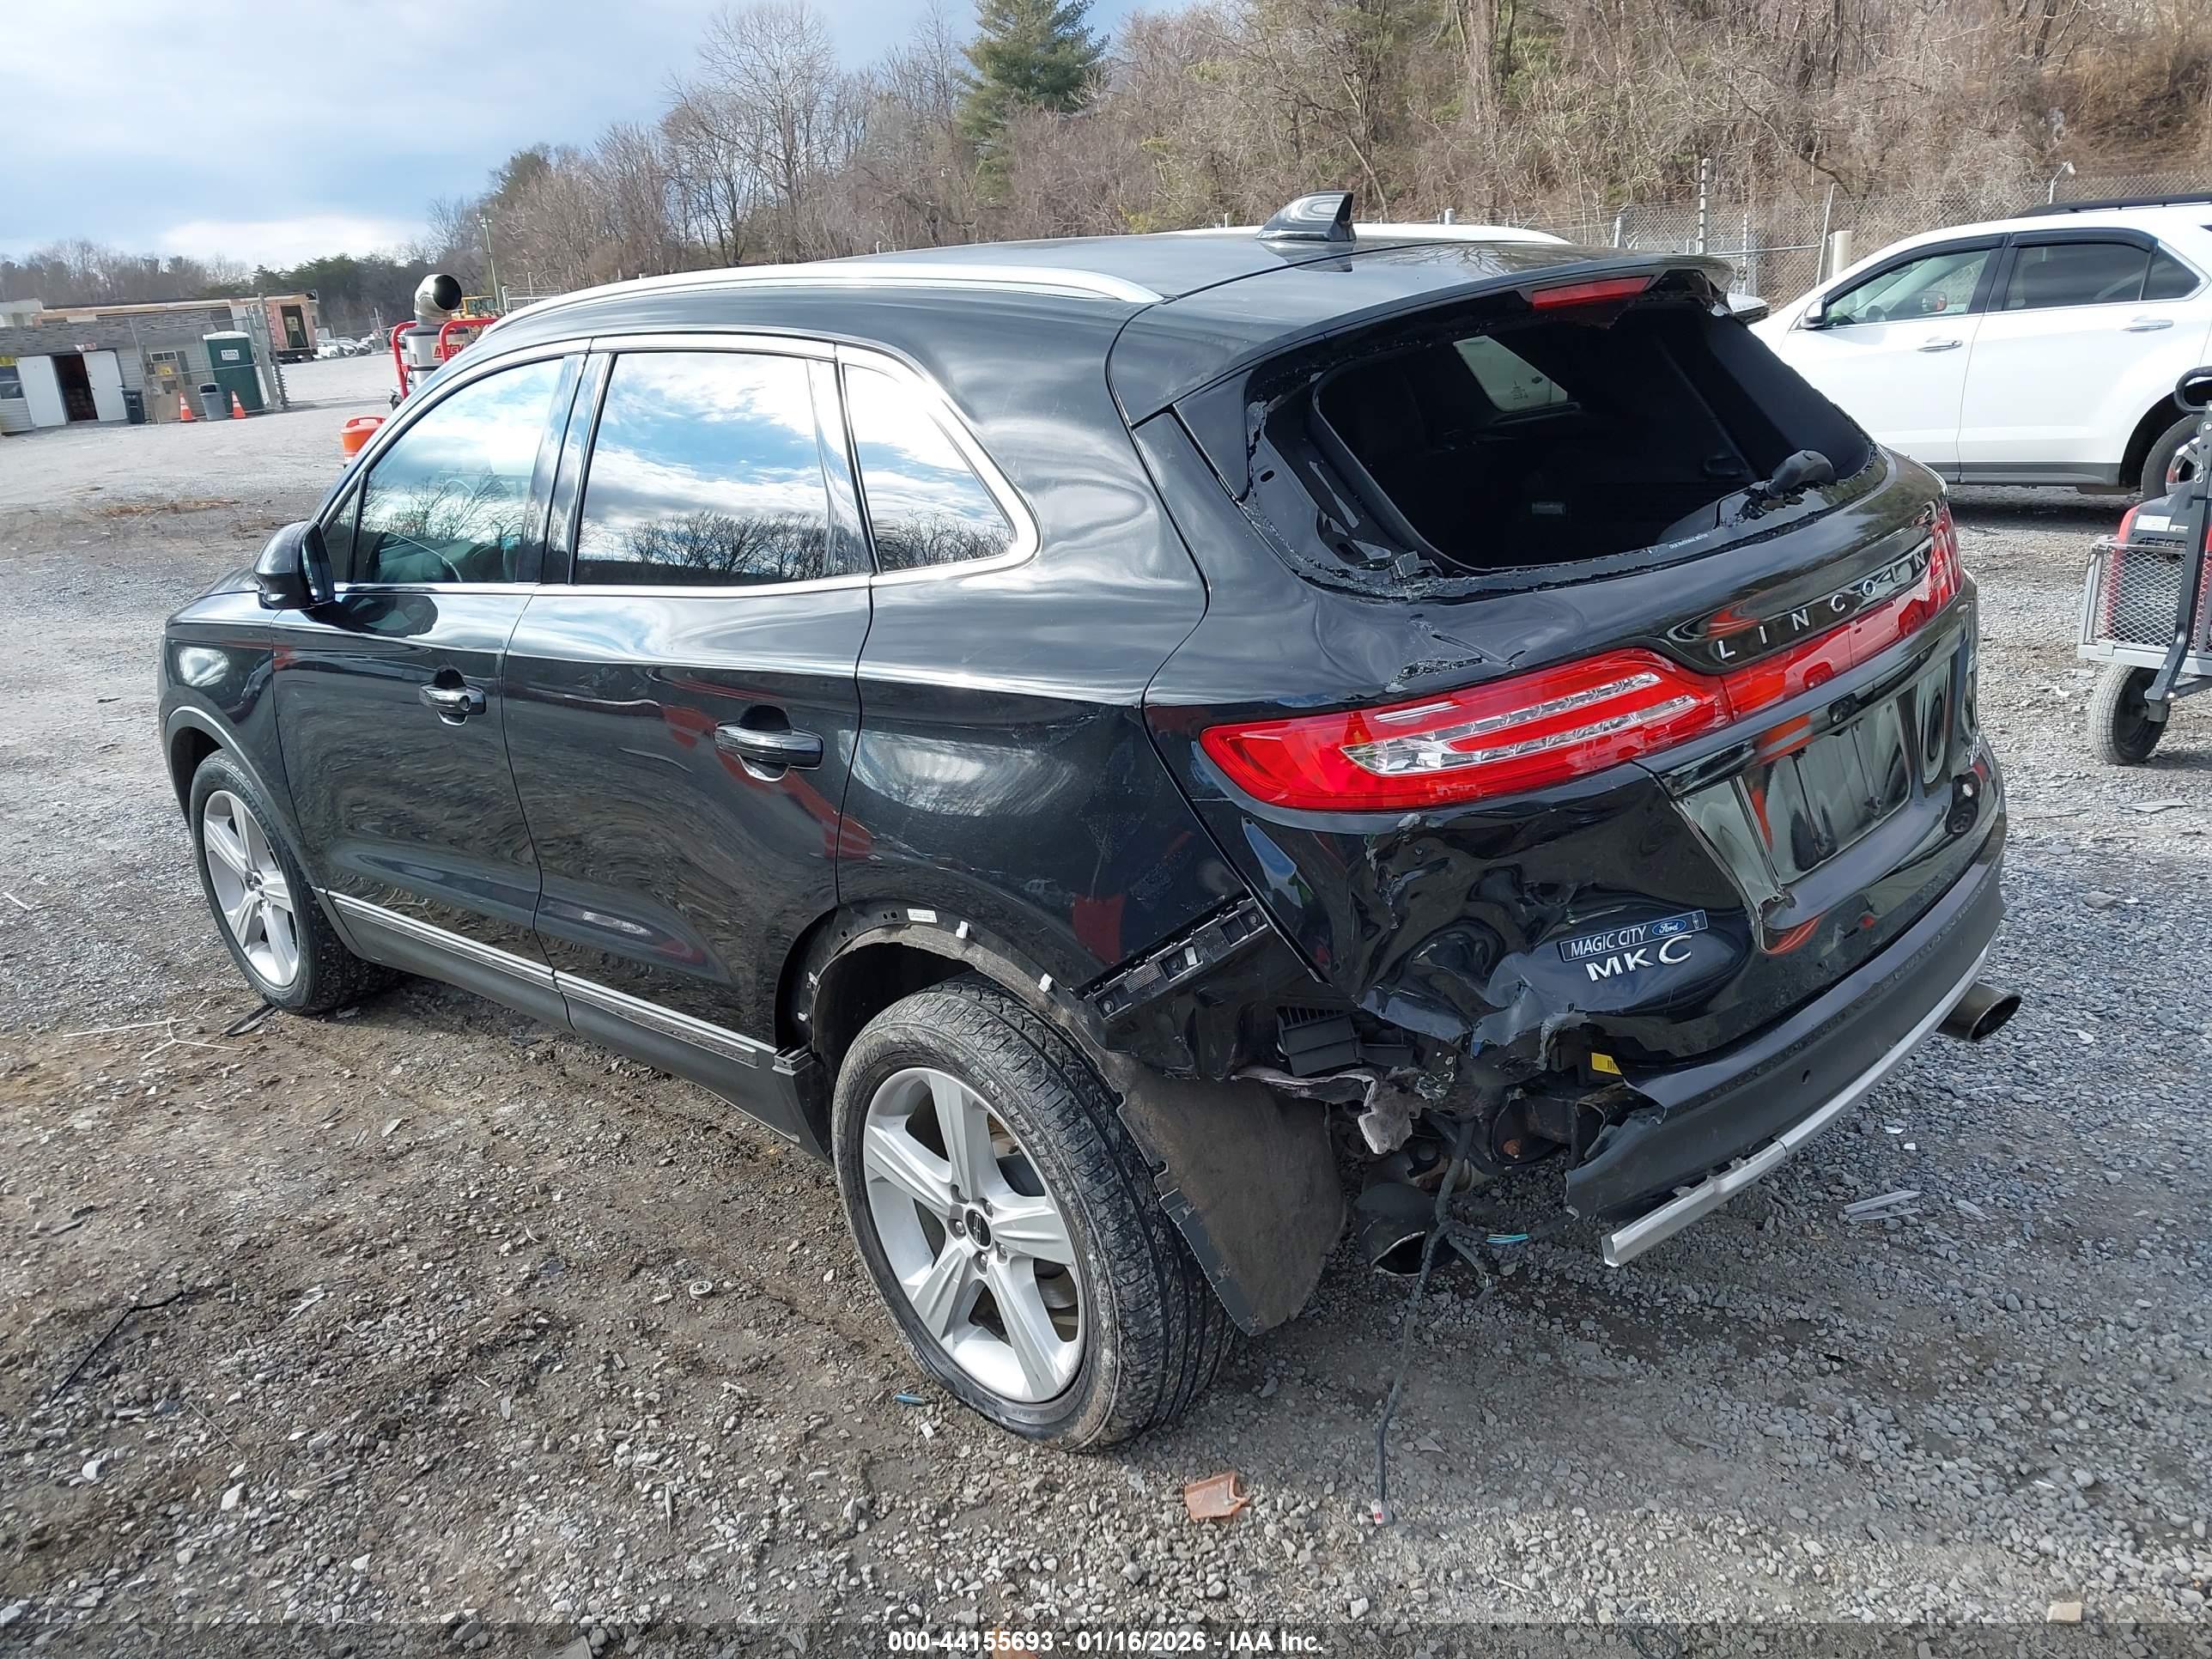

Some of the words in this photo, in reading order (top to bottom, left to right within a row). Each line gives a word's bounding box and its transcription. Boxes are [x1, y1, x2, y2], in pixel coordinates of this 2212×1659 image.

[1717, 550, 1927, 660] LINCOLN
[1570, 933, 1615, 958] MAGIC
[1618, 926, 1648, 945] CITY
[1657, 920, 1682, 935] Ford
[1585, 934, 1693, 982] MKC
